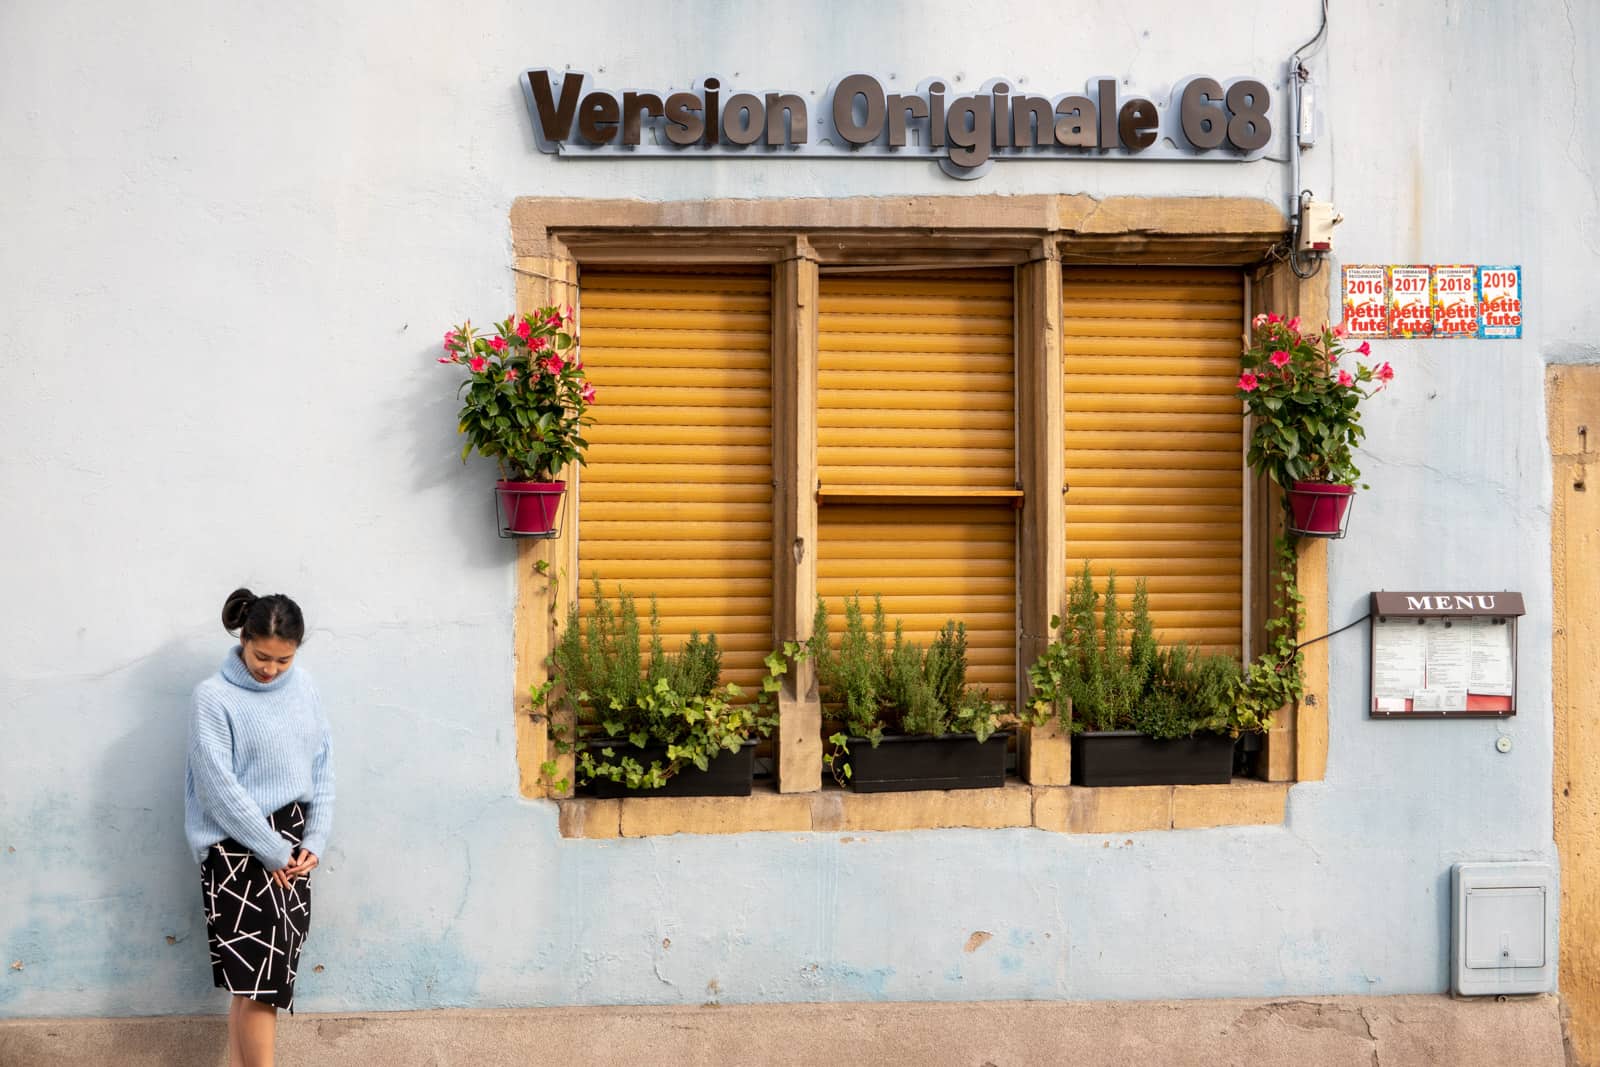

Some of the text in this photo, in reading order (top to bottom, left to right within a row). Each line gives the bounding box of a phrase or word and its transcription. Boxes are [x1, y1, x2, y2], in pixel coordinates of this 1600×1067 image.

[525, 69, 1273, 169] Version Originale 68
[1348, 280, 1382, 295] 2016
[1395, 278, 1427, 292] 2017
[1439, 278, 1471, 291] 2018
[1483, 272, 1516, 288] 2019
[1344, 304, 1386, 321] petit
[1390, 305, 1432, 322] petit
[1435, 304, 1477, 321] petit
[1479, 298, 1521, 315] petit
[1351, 317, 1387, 331] futé
[1397, 318, 1433, 333] futé
[1442, 318, 1478, 332] futé
[1406, 595, 1496, 610] MENU
